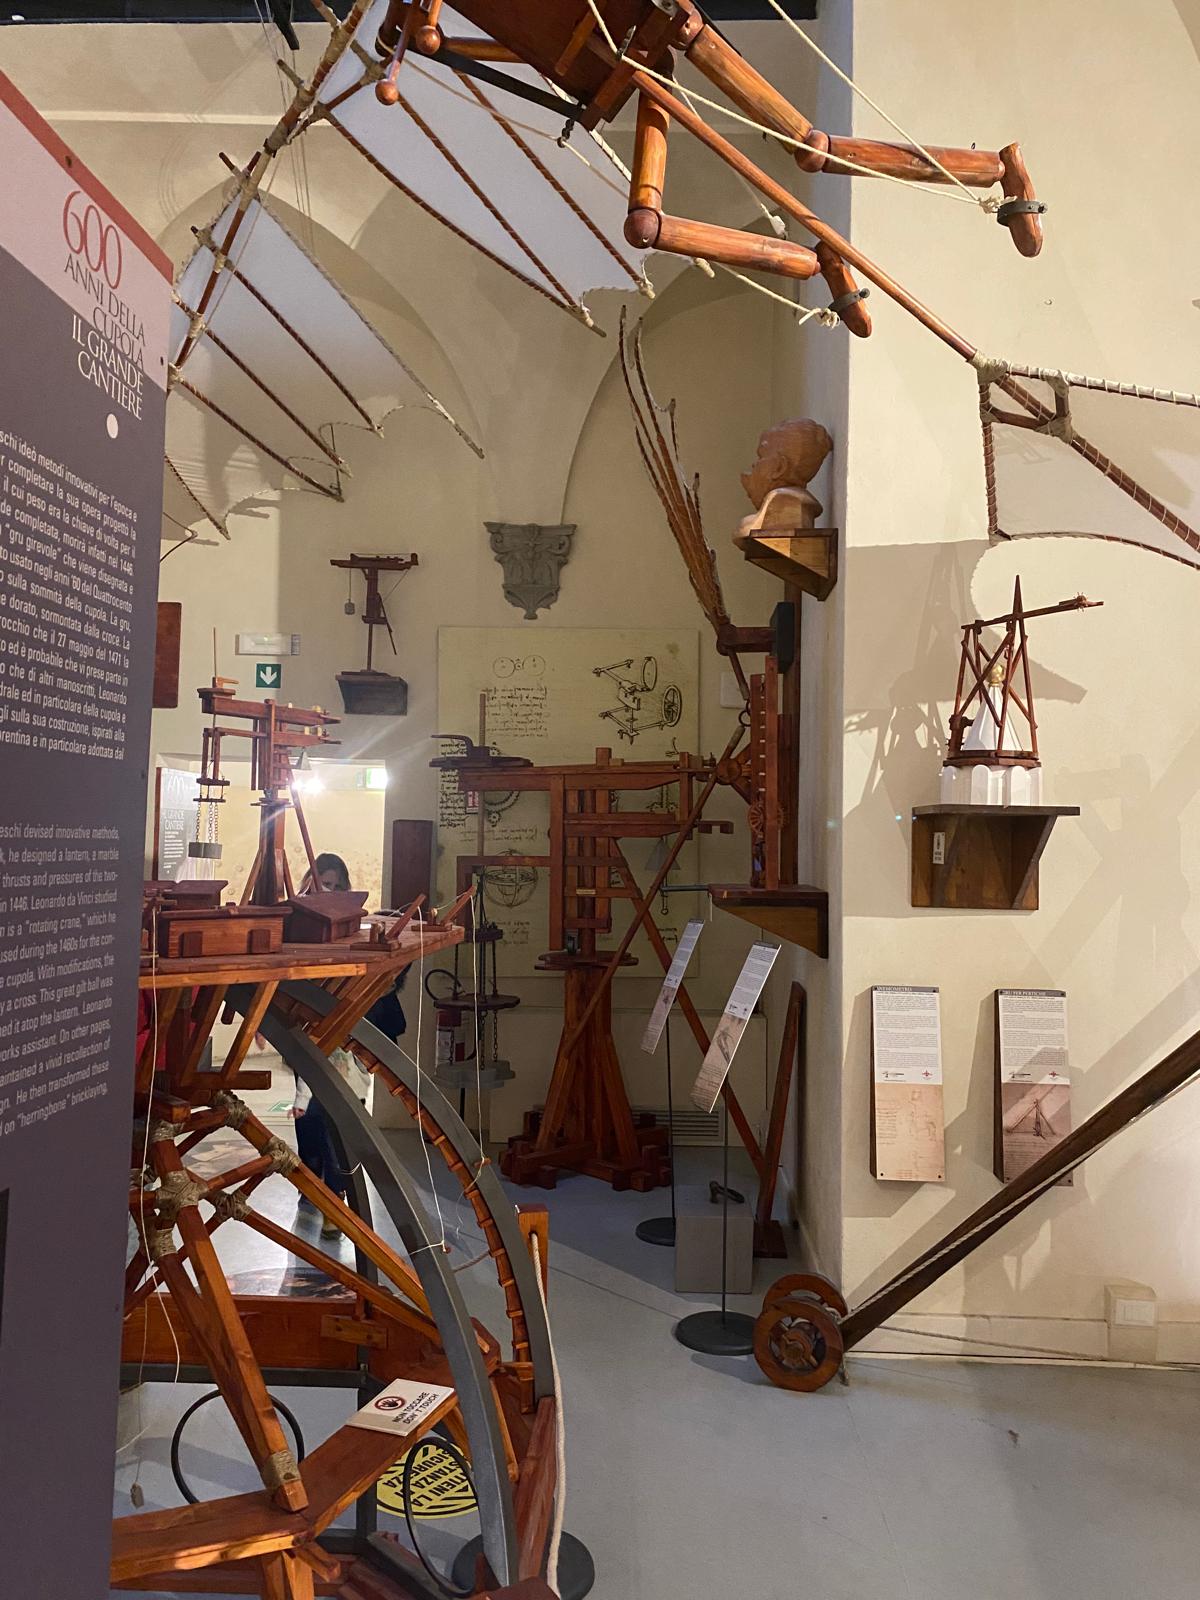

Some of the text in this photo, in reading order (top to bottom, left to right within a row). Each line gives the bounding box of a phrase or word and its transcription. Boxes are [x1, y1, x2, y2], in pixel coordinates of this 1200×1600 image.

[63, 190, 122, 289] 600
[64, 253, 146, 347] ANNI DELLA
[73, 314, 143, 396] IL GRANDE
[93, 306, 143, 373] CUPOLA
[78, 350, 142, 421] CANTIERE
[19, 438, 37, 462] ideò
[38, 453, 64, 478] metodi
[65, 466, 98, 499] innovativi
[99, 491, 110, 505] per
[110, 495, 132, 520] l'epoca
[133, 512, 138, 522] e
[4, 475, 9, 494] il
[11, 484, 24, 501] cui
[26, 492, 46, 512] peso
[48, 504, 61, 519] era
[63, 508, 70, 524] la
[72, 515, 95, 537] chiave
[96, 527, 103, 541] di
[104, 533, 119, 550] volta
[121, 542, 130, 556] per
[8, 460, 54, 495] completare
[56, 483, 64, 500] la
[66, 492, 79, 508] sua
[82, 501, 101, 521] opera
[131, 526, 137, 541] la
[14, 508, 61, 542] completata,
[63, 533, 86, 553] morirà
[88, 541, 107, 563] infatti
[108, 554, 118, 568] nel
[10, 551, 33, 571] usato
[34, 561, 53, 581] negli
[54, 570, 70, 587] anni
[82, 580, 93, 596] del
[93, 584, 133, 613] Quattrocento
[63, 551, 134, 595] che viene disegnata e
[7, 573, 27, 591] sulla
[30, 581, 63, 604] sommità
[65, 592, 82, 612] della
[110, 610, 118, 626] La
[9, 593, 130, 650] dorato, sormontata dalla La
[8, 641, 19, 655] ed
[28, 647, 64, 668] probabile
[65, 656, 78, 673] che
[79, 661, 86, 675] vi
[86, 665, 105, 680] prese
[105, 671, 122, 685] parte
[122, 672, 129, 687] in
[33, 624, 130, 669] che il 27 maggio del 1471 la
[9, 663, 127, 706] che di altri manoscritti, Leonardo
[11, 707, 126, 742] sulla sua costruzione, ispirati alla
[22, 687, 127, 724] ed in particolare della cupola e
[33, 732, 126, 761] e in particolare adottata dal
[24, 823, 54, 839] devised
[56, 823, 91, 839] innovative
[9, 847, 20, 863] he
[22, 847, 57, 866] designed
[59, 849, 64, 862] a
[3, 868, 103, 888] thrusts and pressures of the
[31, 887, 117, 910] Leonardo da Vinci studied
[7, 921, 15, 937] is
[17, 924, 22, 936] a
[20, 945, 45, 960] during
[45, 940, 58, 955] the
[37, 963, 56, 980] With
[6, 999, 13, 1013] a
[40, 986, 56, 1003] This
[56, 983, 76, 1002] great
[87, 975, 100, 992] ball
[14, 995, 113, 1034] it atop the Leonardo
[60, 1027, 70, 1044] On
[38, 1062, 44, 1074] a
[16, 1088, 28, 1105] He
[30, 1083, 48, 1100] then
[4, 1120, 16, 1136] on
[419, 1393, 440, 1409] TOUCH
[411, 1461, 460, 1489] STANZA
[411, 1494, 433, 1507] LA
